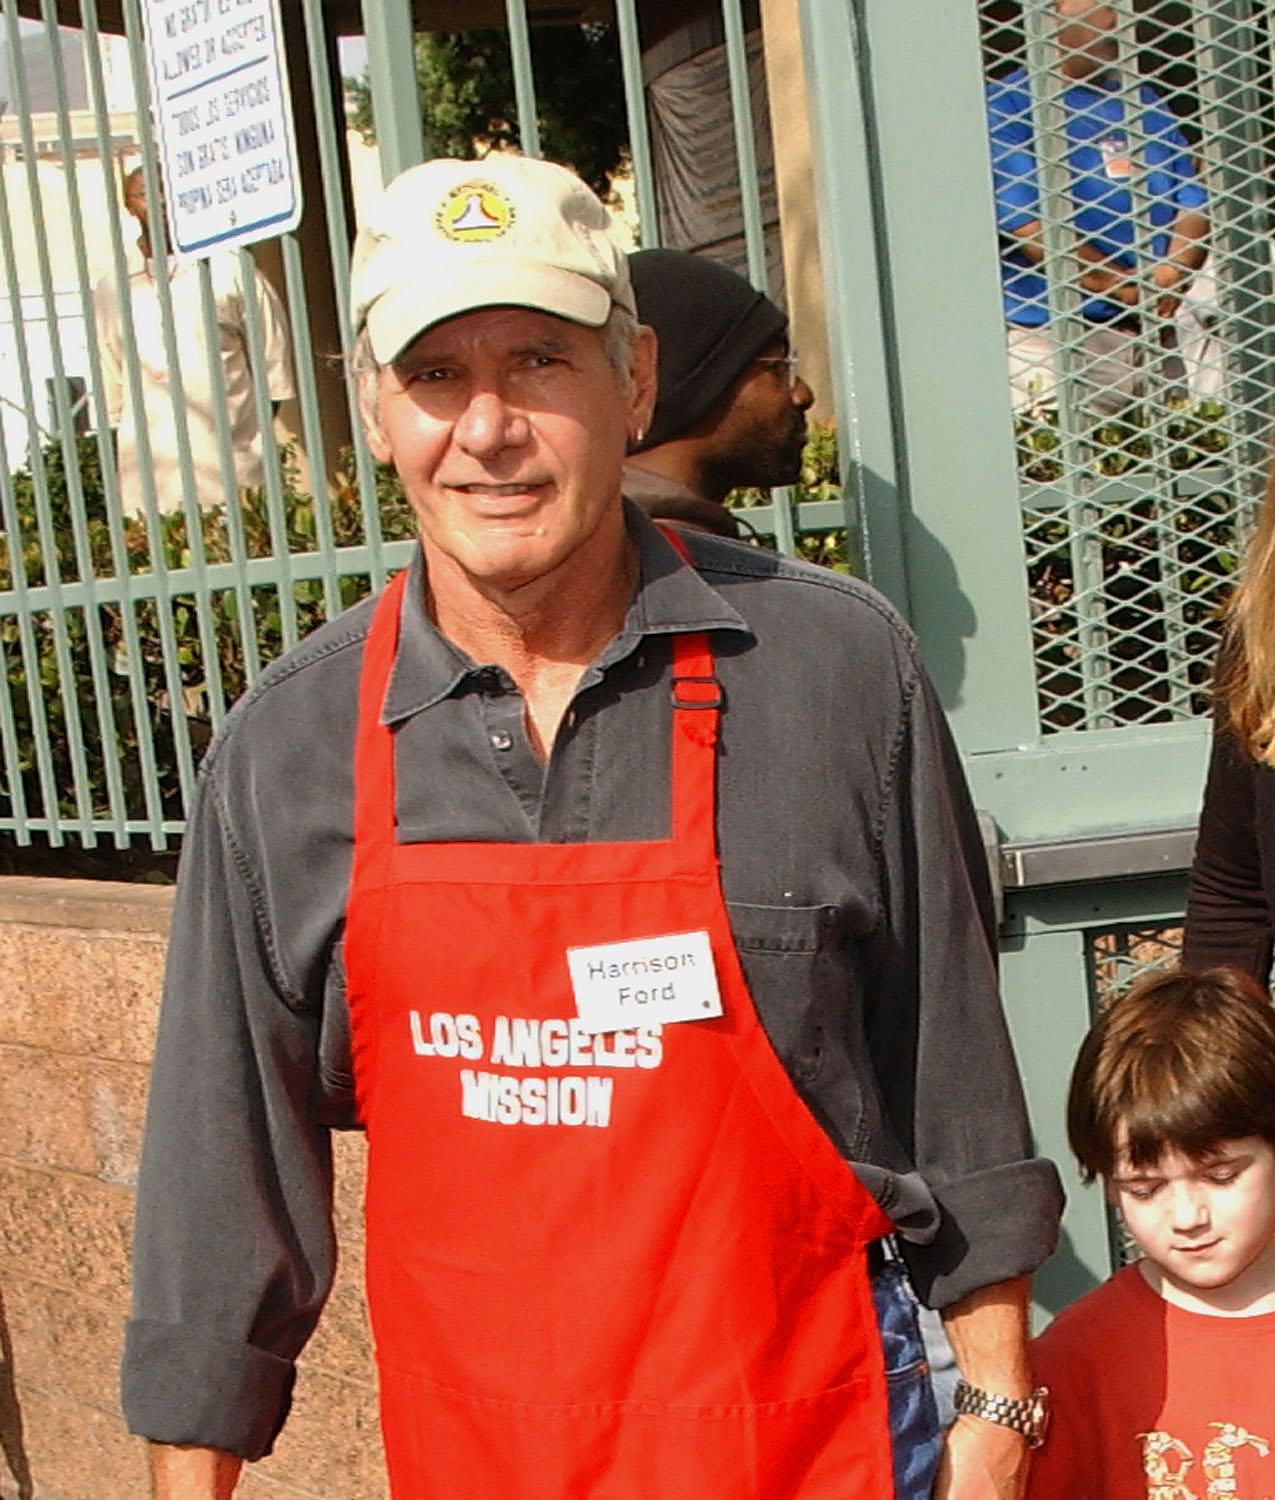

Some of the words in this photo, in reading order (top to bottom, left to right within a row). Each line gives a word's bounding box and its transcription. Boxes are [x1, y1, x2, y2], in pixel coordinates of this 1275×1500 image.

[588, 952, 695, 981] Harrison
[618, 982, 676, 1006] Ford
[409, 1010, 485, 1061] LOS
[490, 1015, 664, 1070] ANGELES
[459, 1069, 614, 1128] MISSION
